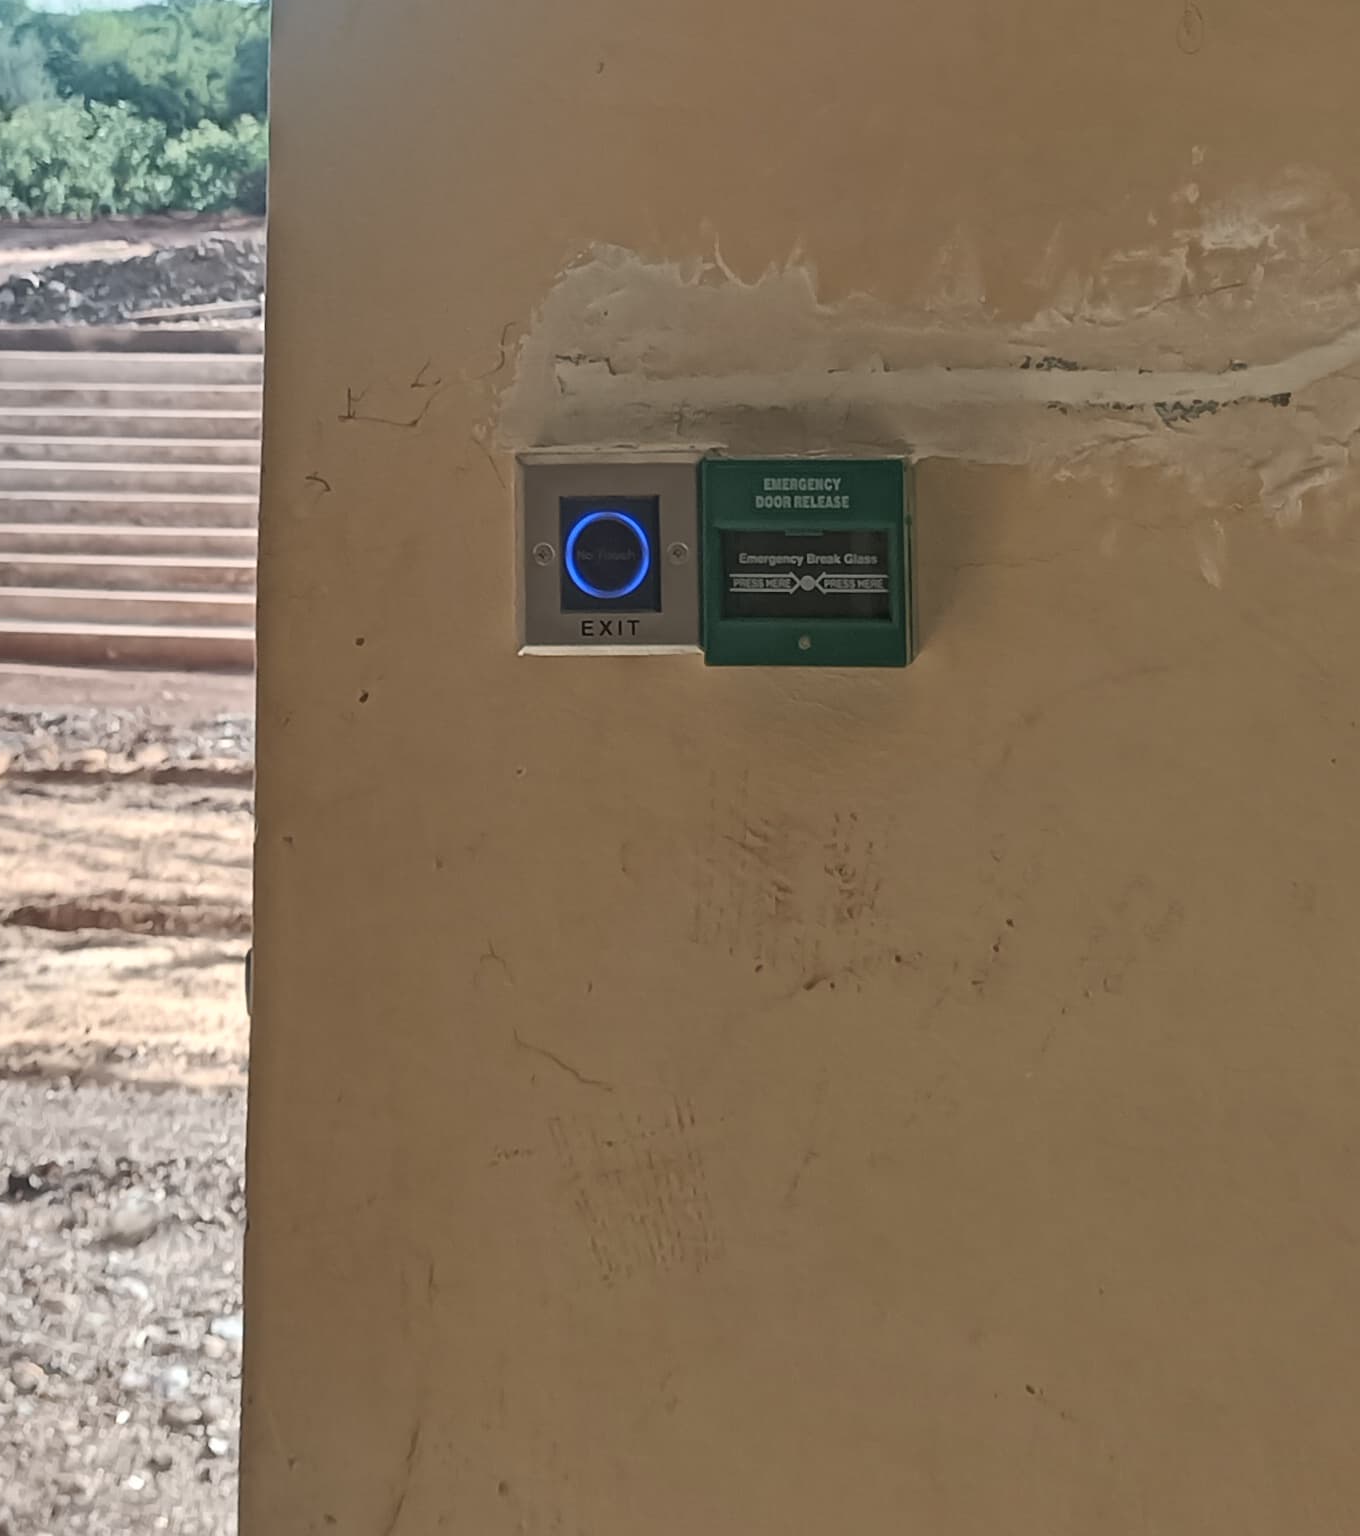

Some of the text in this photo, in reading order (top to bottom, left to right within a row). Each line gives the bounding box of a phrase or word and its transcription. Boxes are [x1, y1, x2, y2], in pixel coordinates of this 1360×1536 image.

[763, 477, 842, 491] EMERGENCY
[755, 495, 850, 509] DOOR RELEASE
[738, 552, 878, 567] Emergency Break Glass
[732, 578, 791, 589] PRESS HERE
[823, 579, 884, 589] PRESS HERE
[581, 620, 641, 636] EXIT
